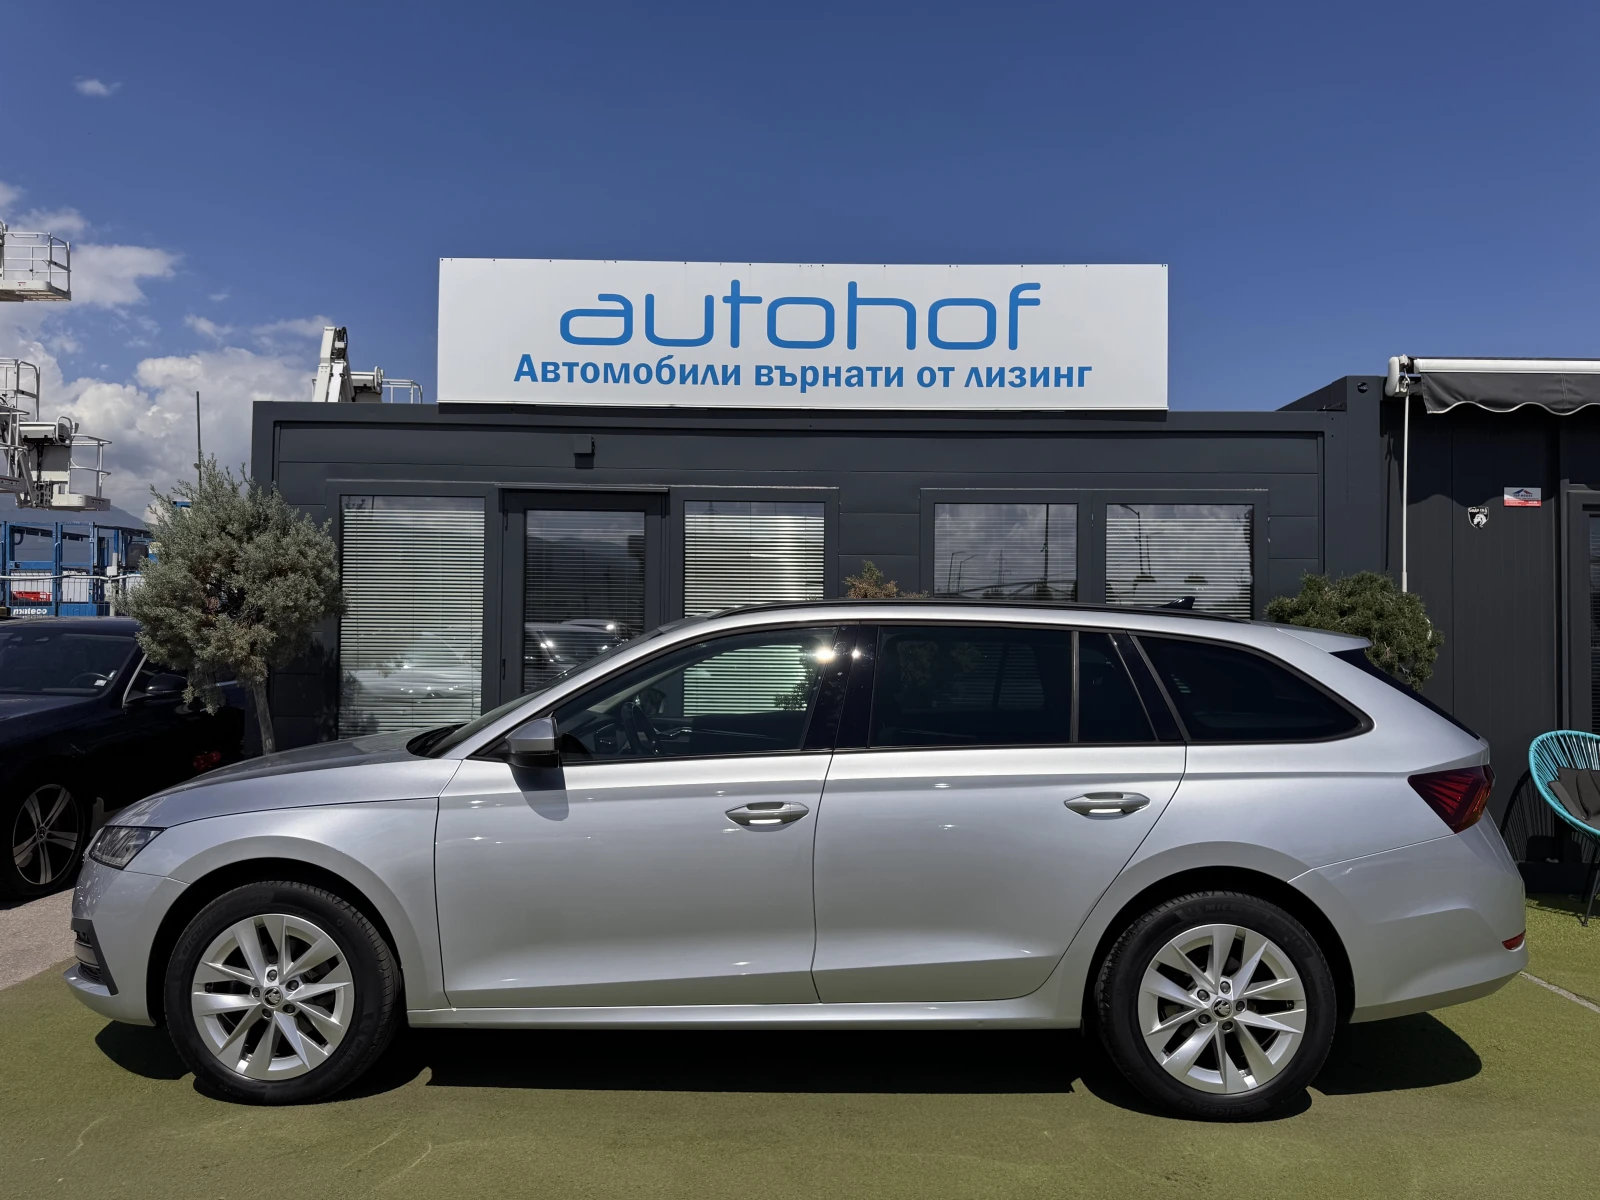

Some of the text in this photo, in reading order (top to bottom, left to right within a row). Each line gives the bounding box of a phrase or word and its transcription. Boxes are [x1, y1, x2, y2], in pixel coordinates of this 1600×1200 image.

[559, 279, 1042, 351] autohof
[513, 353, 1093, 394] Автомобили върнати от лизинг
